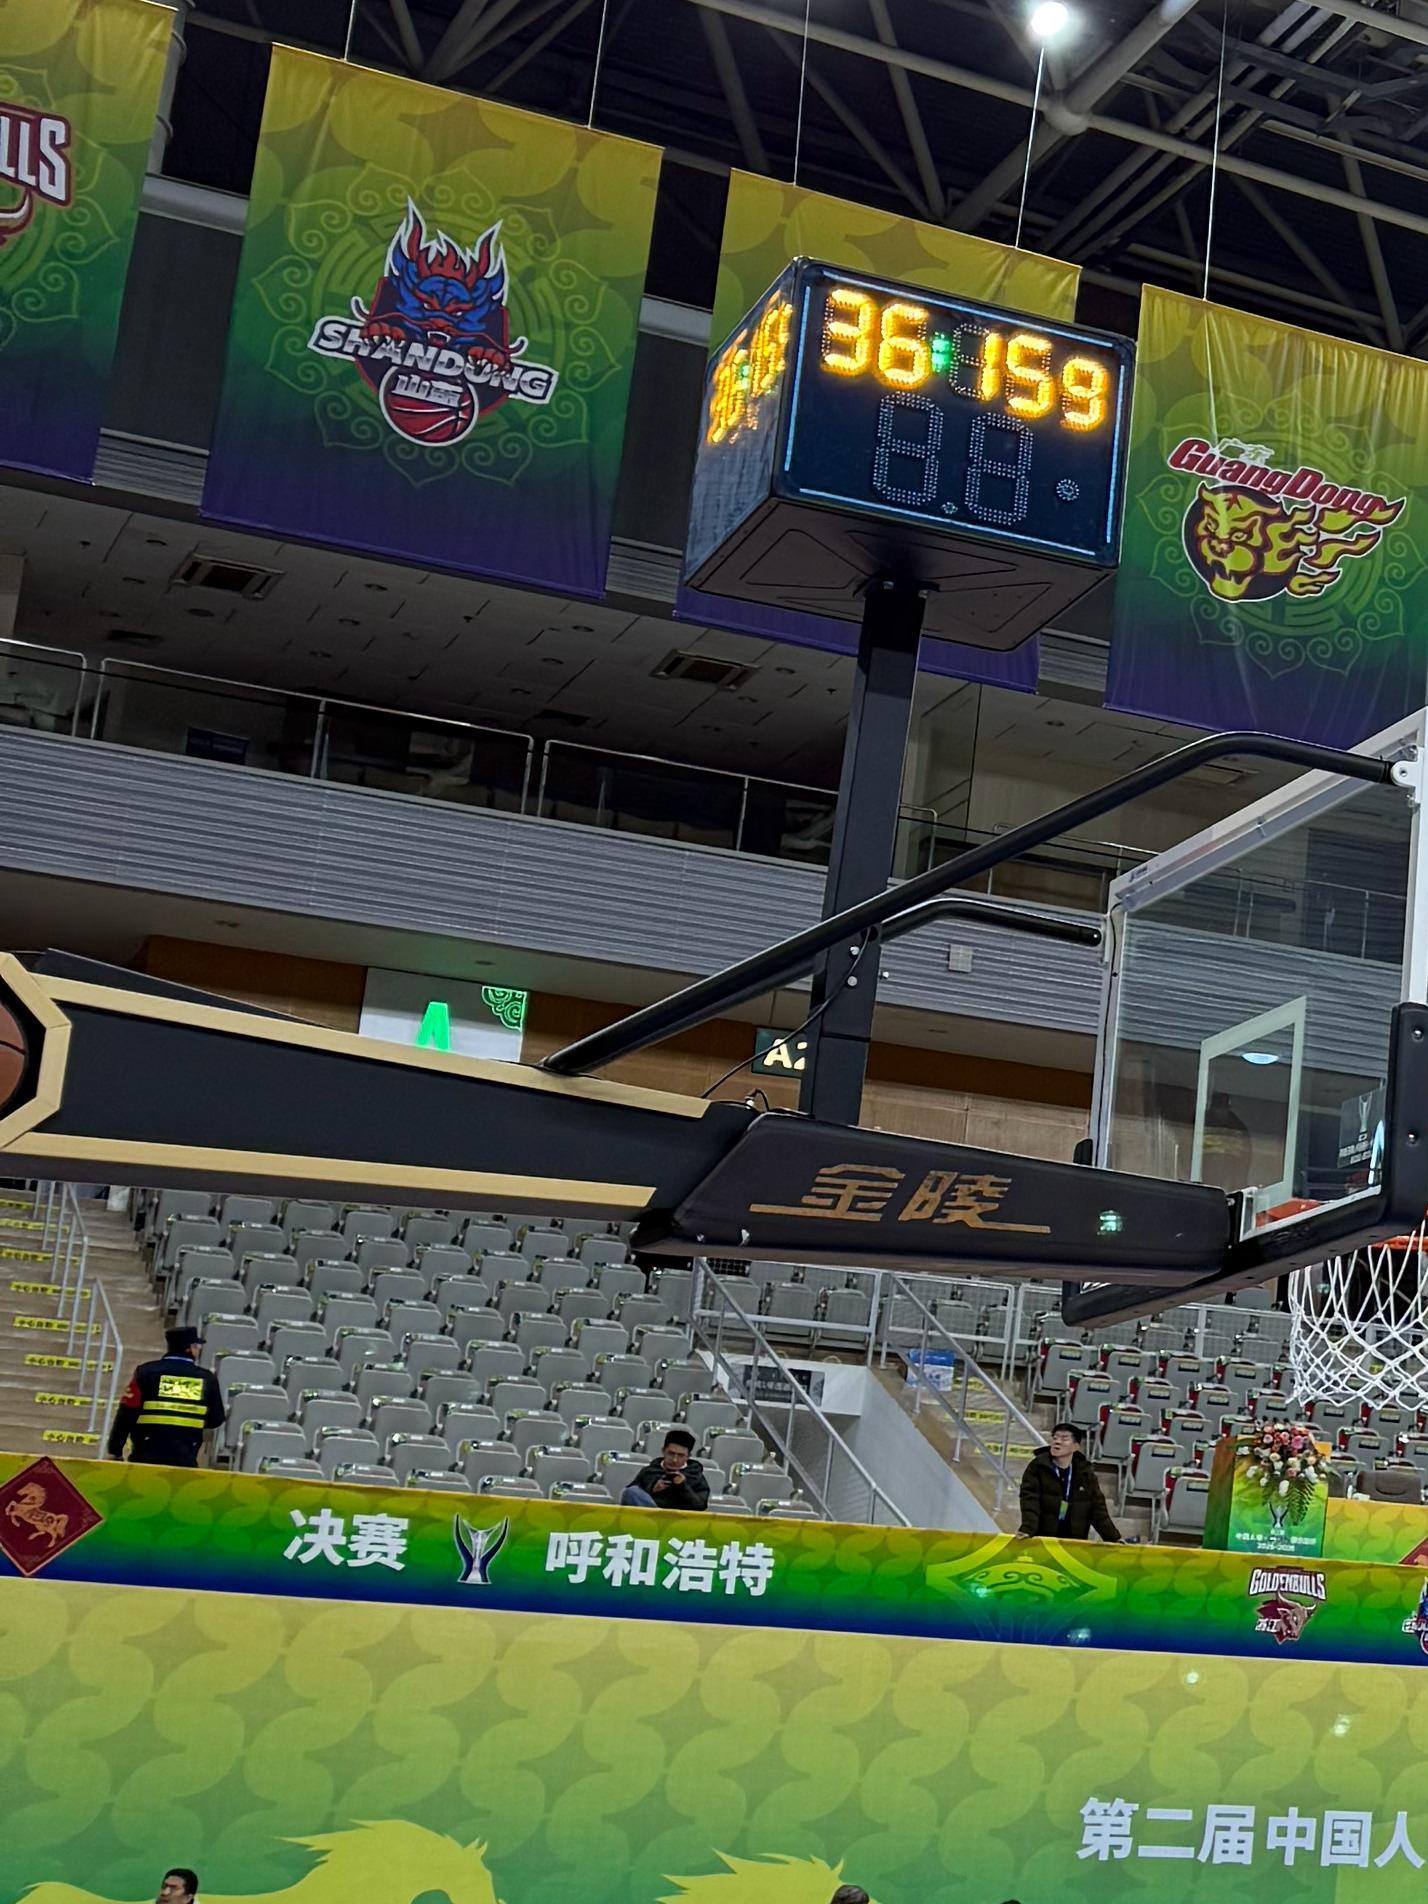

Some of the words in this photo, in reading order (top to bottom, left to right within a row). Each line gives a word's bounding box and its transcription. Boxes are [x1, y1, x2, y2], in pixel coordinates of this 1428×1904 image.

[313, 319, 552, 400] SHANDONG
[751, 1163, 1050, 1232] 金陵
[283, 1506, 409, 1572] 决赛
[545, 1530, 776, 1598] 呼和浩特
